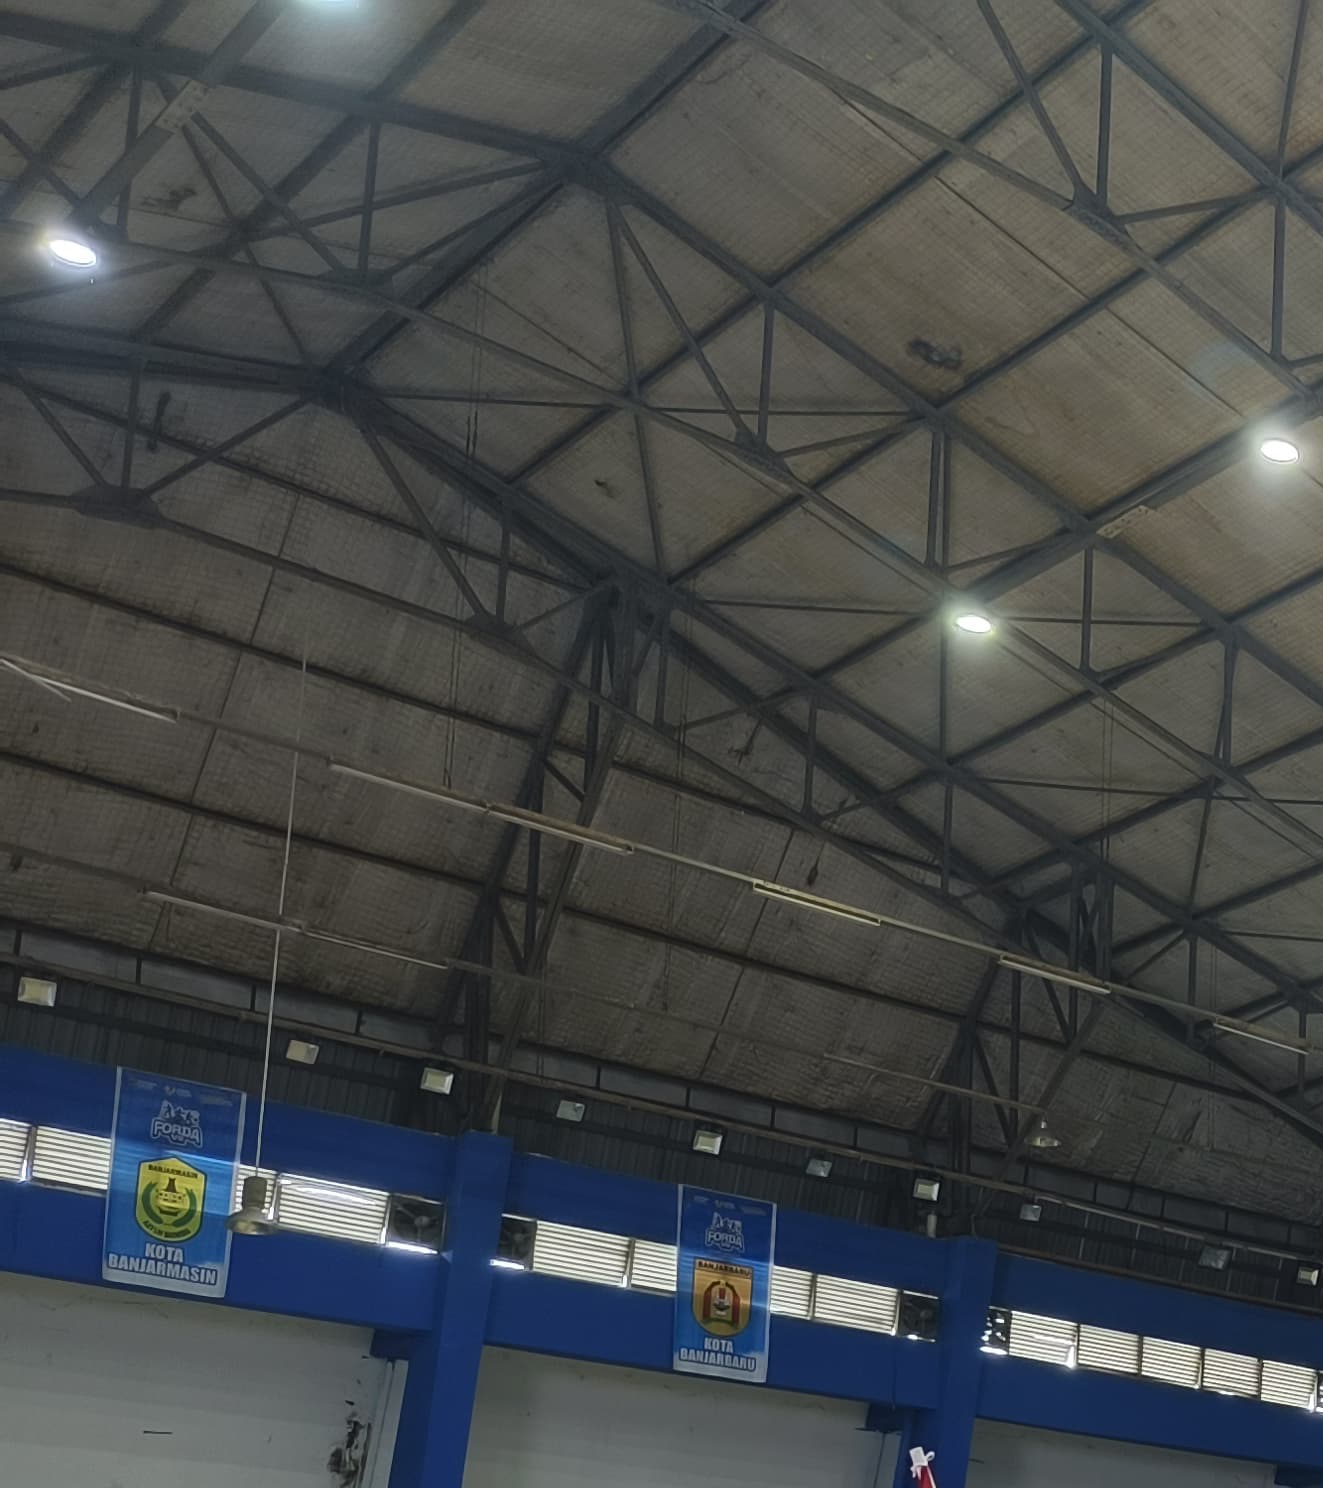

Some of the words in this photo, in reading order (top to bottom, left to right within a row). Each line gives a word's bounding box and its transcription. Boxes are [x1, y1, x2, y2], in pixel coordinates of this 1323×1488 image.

[154, 1121, 200, 1145] FORDA
[148, 1164, 198, 1180] BANJARMASIN
[708, 1232, 743, 1248] FORDA
[145, 1243, 183, 1263] KOTA
[108, 1253, 217, 1285] BANJARMASIN
[704, 1337, 733, 1353] KOTA
